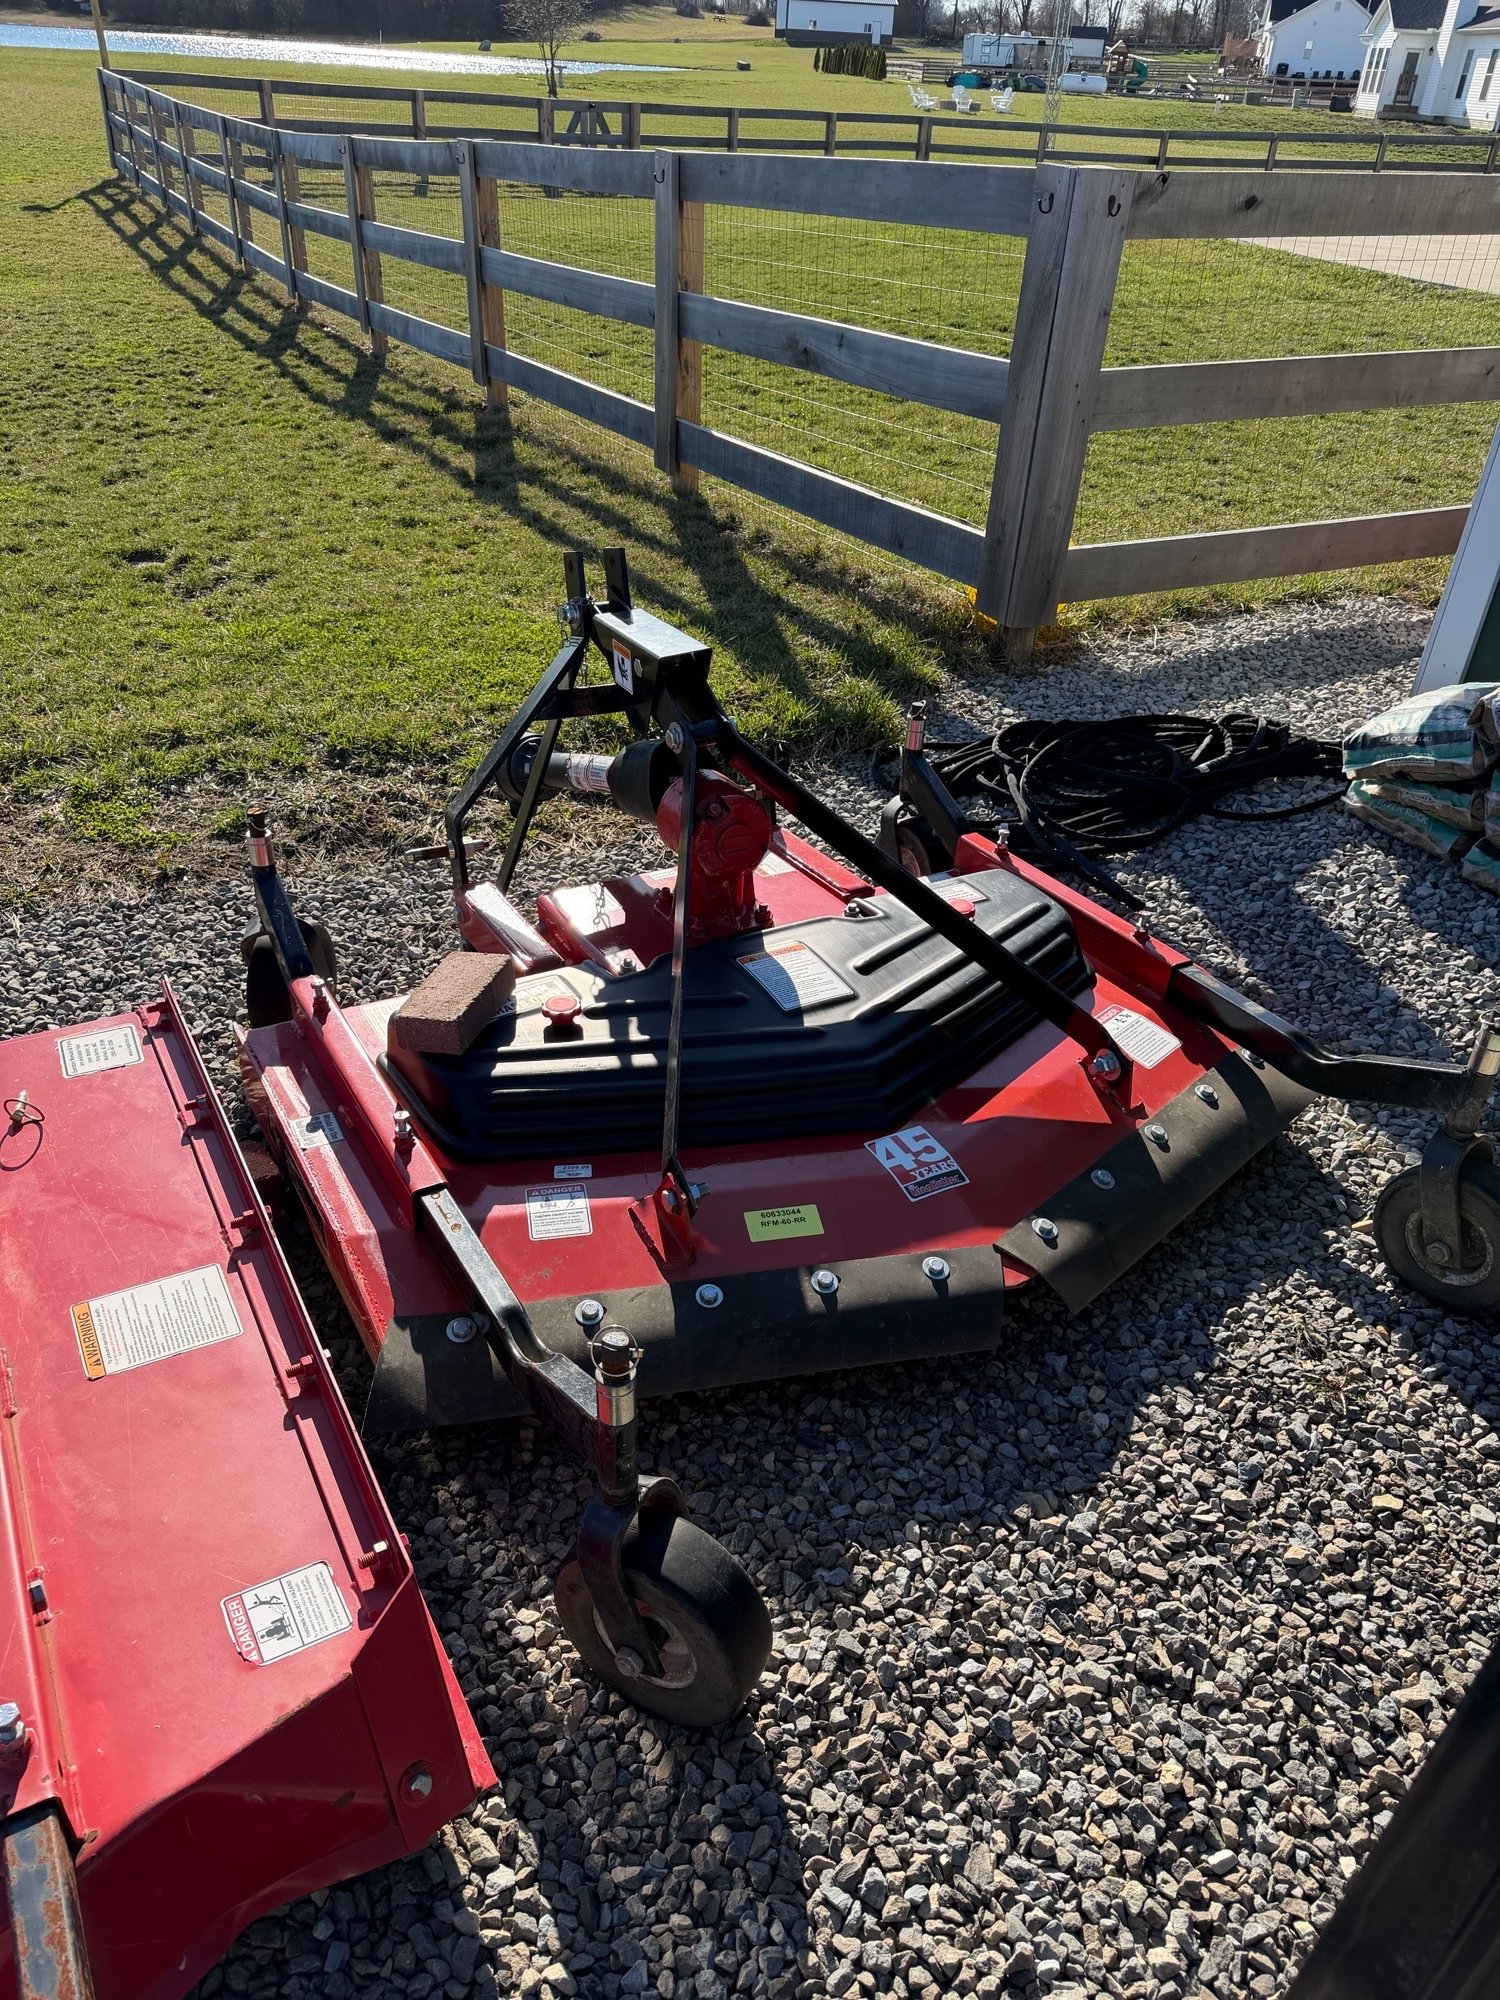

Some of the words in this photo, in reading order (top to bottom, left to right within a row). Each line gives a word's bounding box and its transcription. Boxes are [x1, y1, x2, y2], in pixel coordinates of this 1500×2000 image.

[874, 1126, 950, 1171] 45
[909, 1158, 958, 1182] YEARS
[540, 1185, 581, 1194] DANGER
[760, 1208, 802, 1219] 60633044
[760, 1216, 806, 1228] RFM-60-RR
[76, 1311, 99, 1359] WARNING
[285, 1579, 297, 1599] HAZARD
[292, 1598, 304, 1618] OBJECT
[228, 1600, 255, 1651] DANGER
[299, 1616, 311, 1638] THROWN
